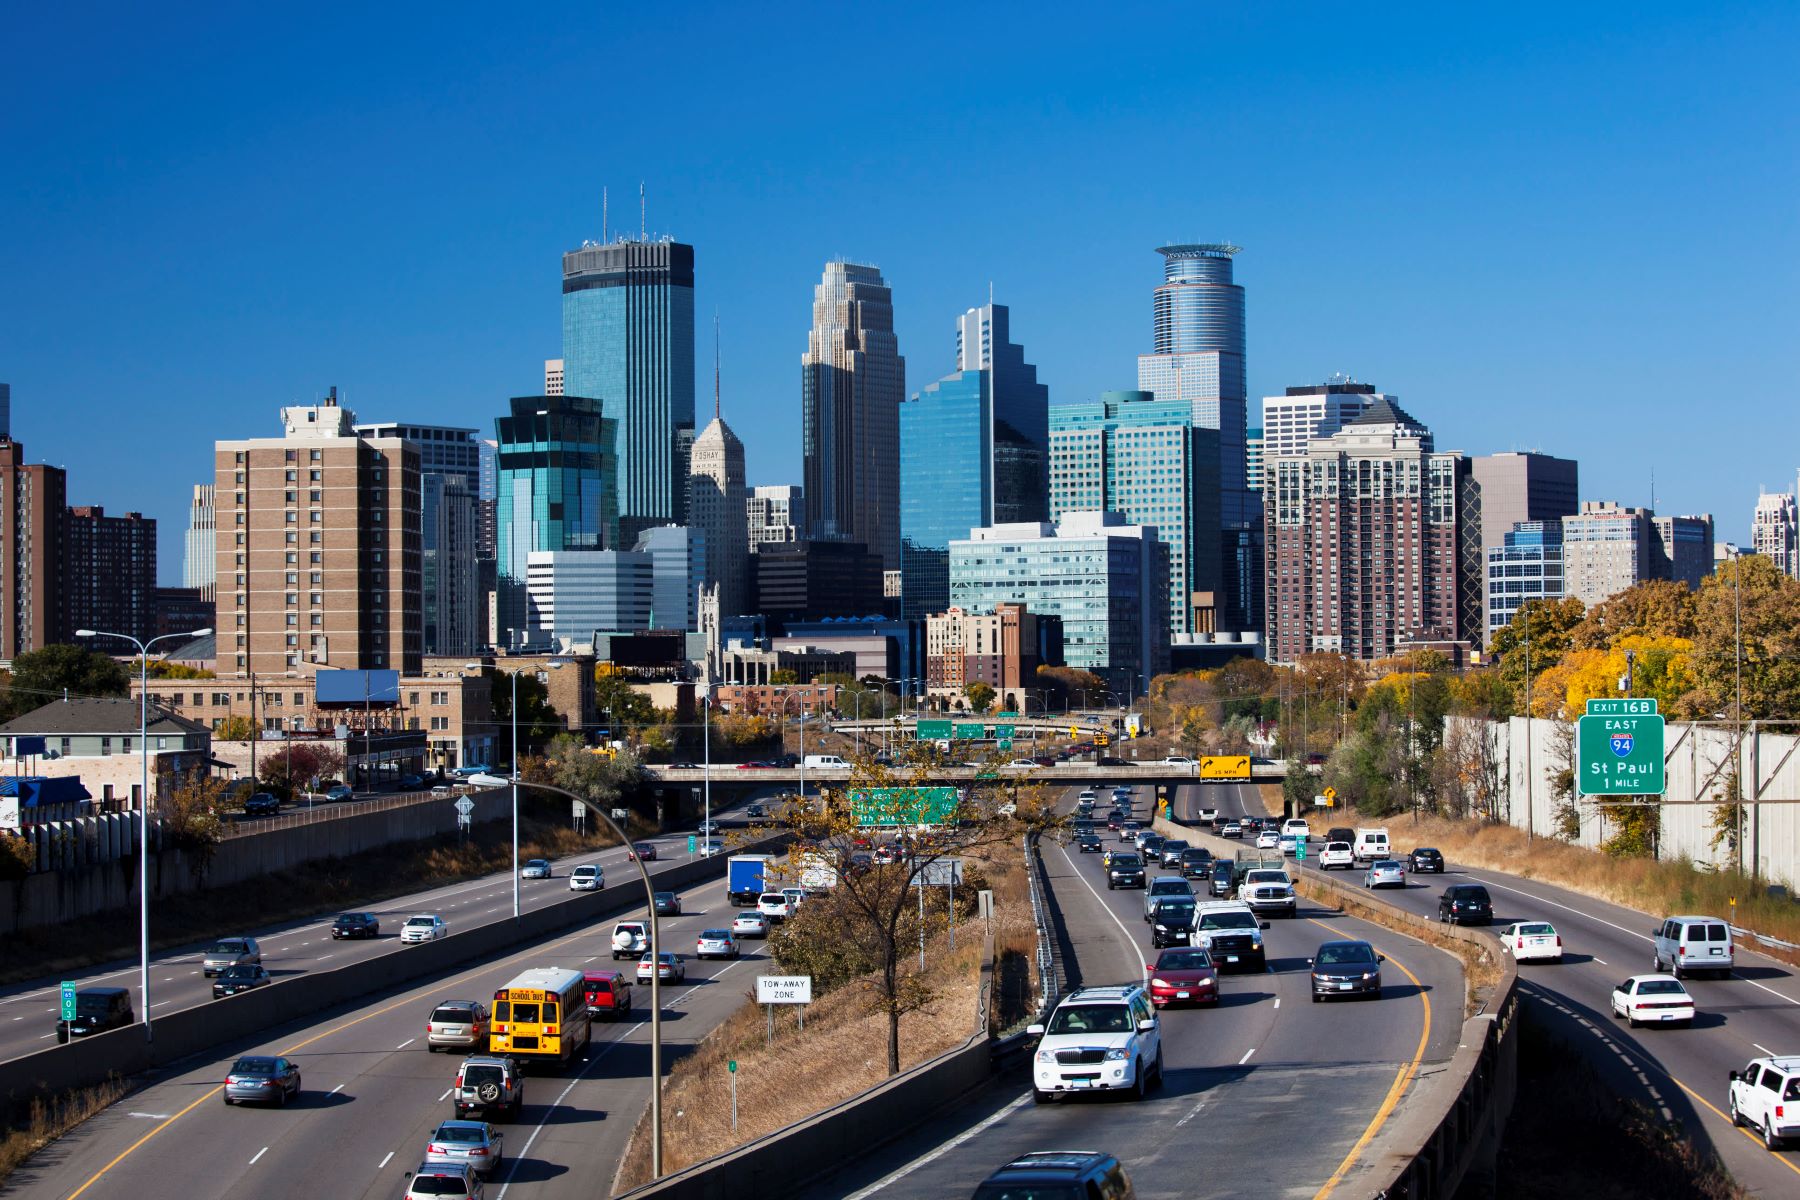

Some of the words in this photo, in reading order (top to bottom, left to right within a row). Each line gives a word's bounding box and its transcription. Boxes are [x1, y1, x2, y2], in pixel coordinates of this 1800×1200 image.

[1623, 702, 1649, 712] 16B
[1606, 720, 1637, 729] EAST
[1614, 740, 1630, 751] 94
[1591, 762, 1608, 774] St
[1617, 762, 1652, 774] Paul
[1604, 778, 1608, 789] 1
